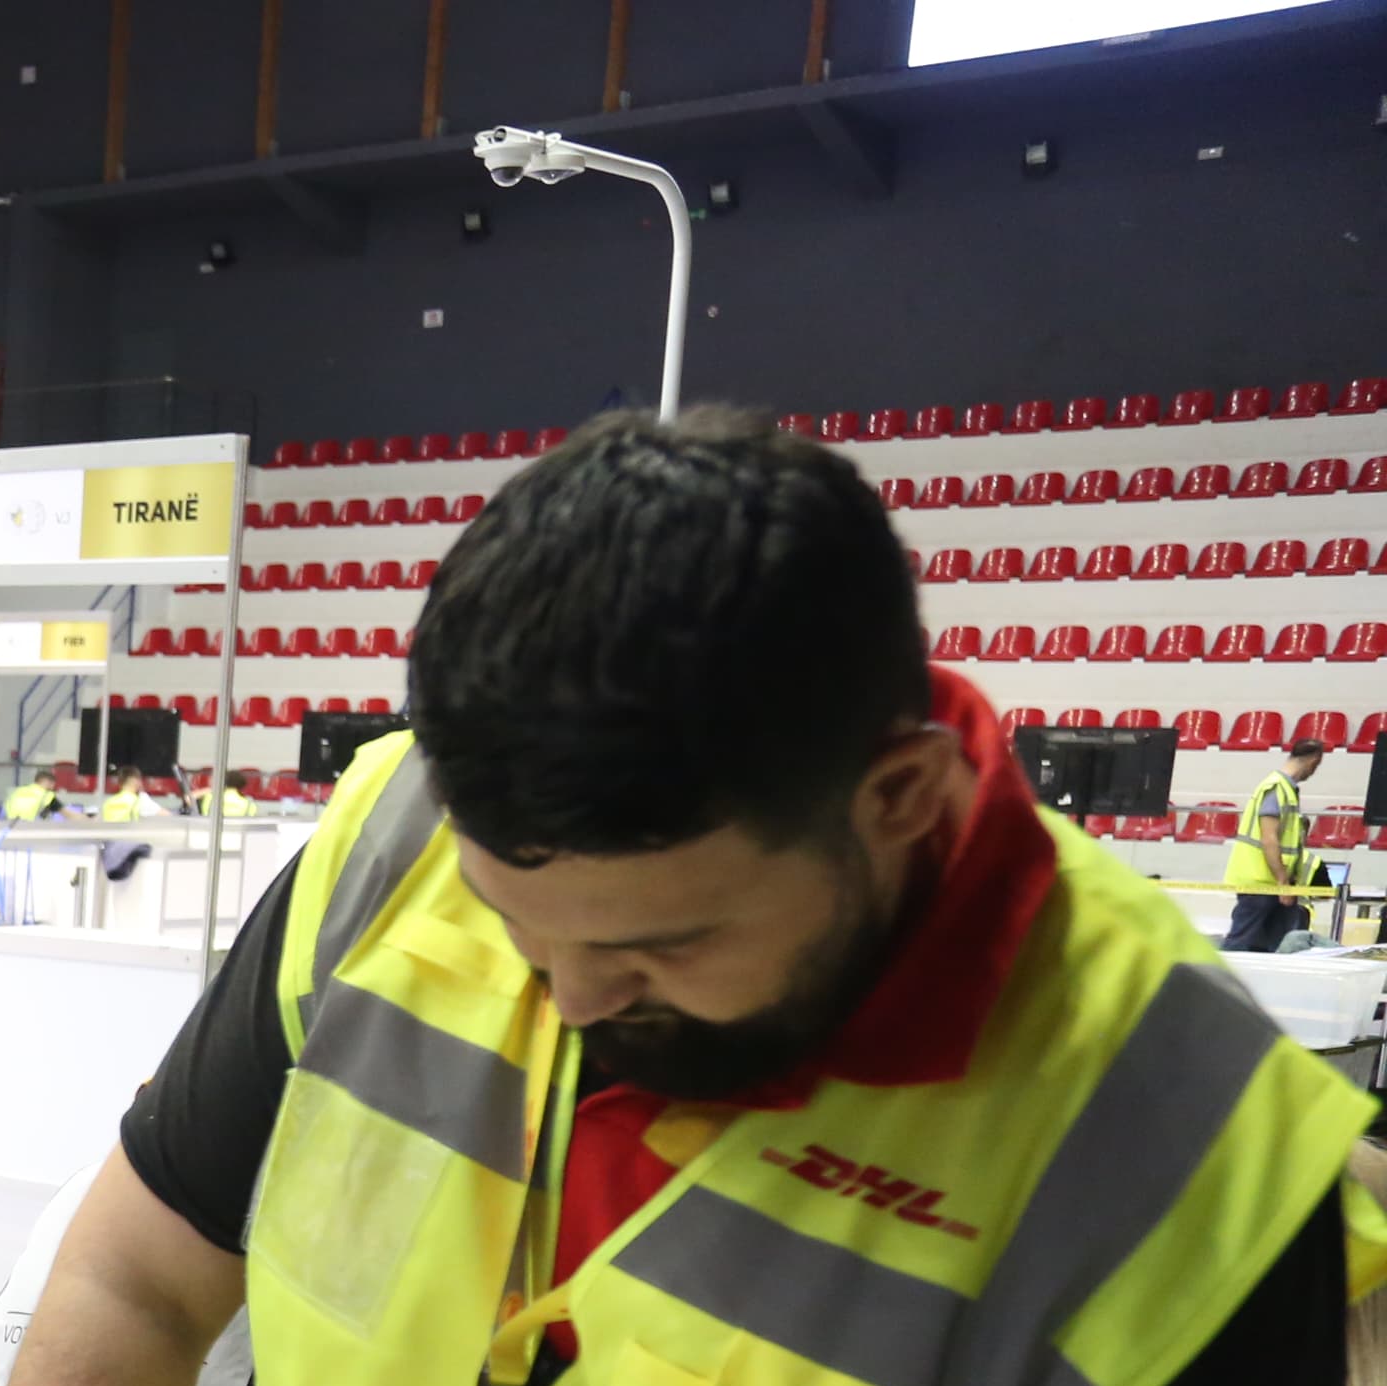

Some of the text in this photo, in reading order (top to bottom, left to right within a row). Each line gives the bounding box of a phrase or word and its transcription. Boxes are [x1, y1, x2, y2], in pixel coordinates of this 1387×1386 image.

[113, 493, 199, 524] TIRANË
[787, 1143, 949, 1229] DHL
[4, 1324, 27, 1344] VO
